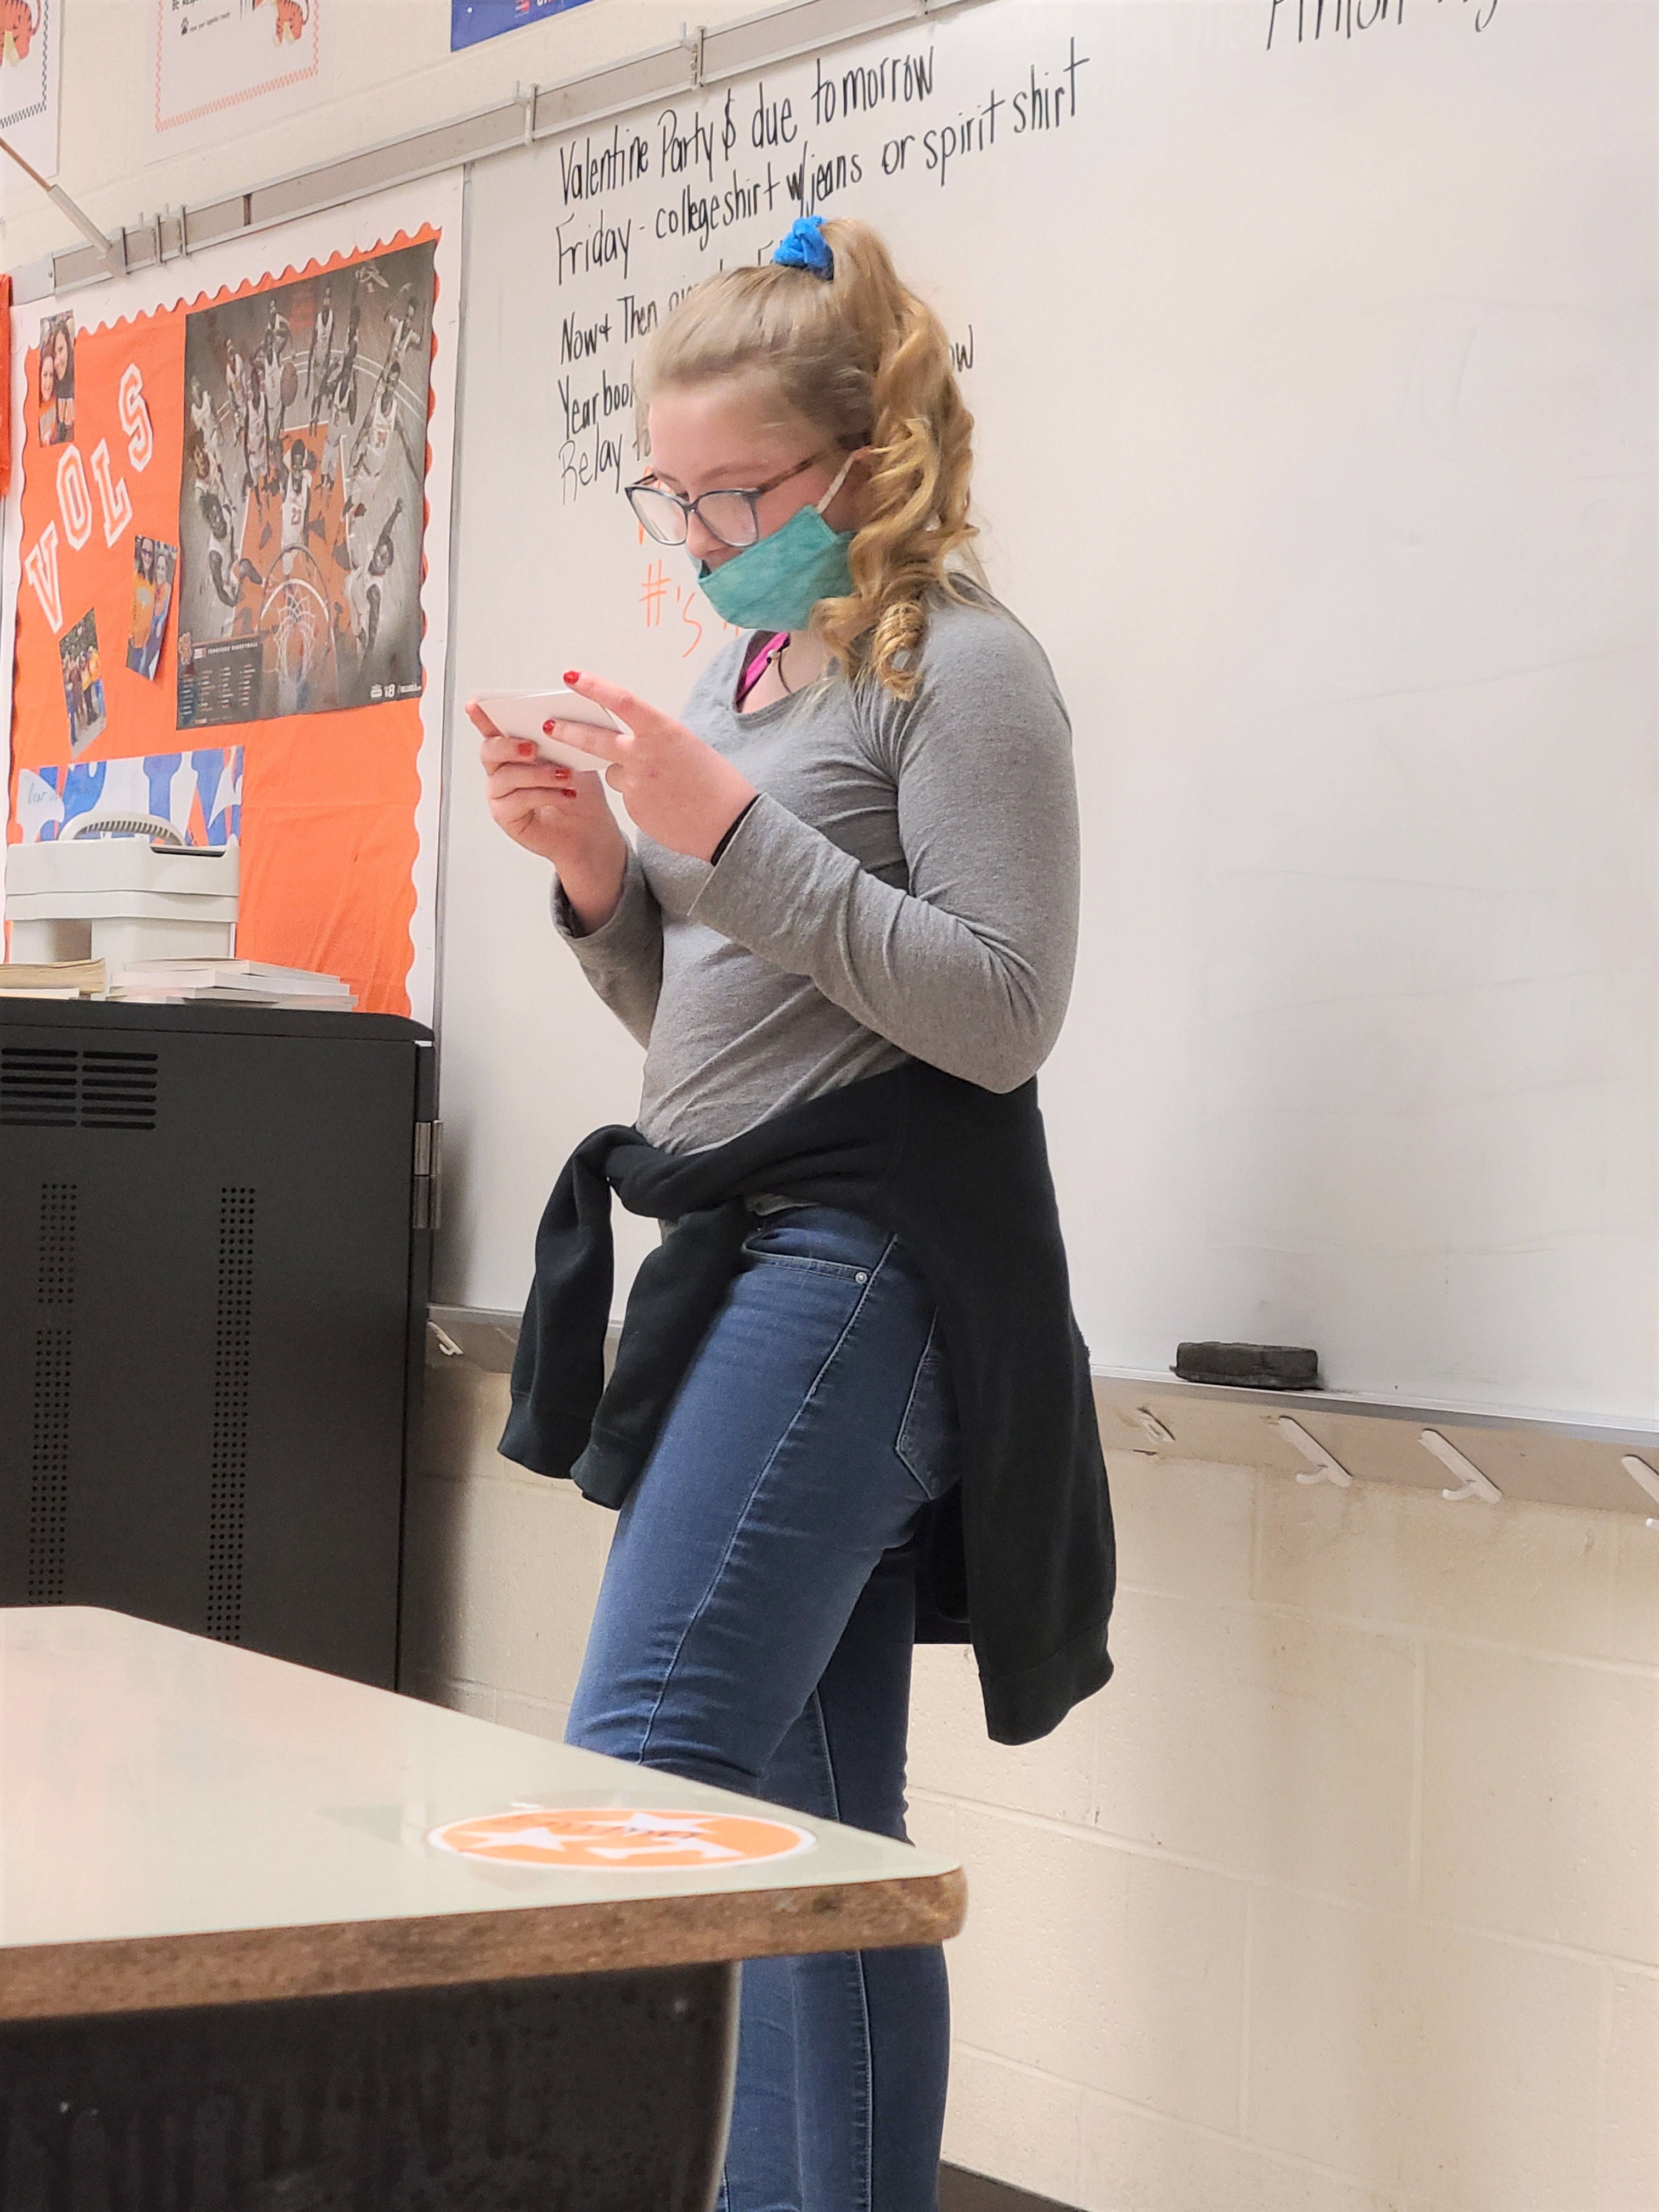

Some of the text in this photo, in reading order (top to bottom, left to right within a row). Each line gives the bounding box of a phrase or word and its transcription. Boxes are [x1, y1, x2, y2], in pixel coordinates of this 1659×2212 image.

[556, 208, 631, 285] Friday
[881, 135, 916, 176] or
[923, 89, 1006, 187] spirit
[1013, 36, 1091, 133] shirt
[560, 125, 648, 206] Valentine
[658, 109, 713, 183] Party
[752, 82, 798, 148] due
[811, 46, 934, 126] tomorrow
[617, 295, 658, 344] Then
[25, 363, 154, 634] VOLS
[558, 421, 623, 505] Relay
[639, 558, 702, 657] #'s
